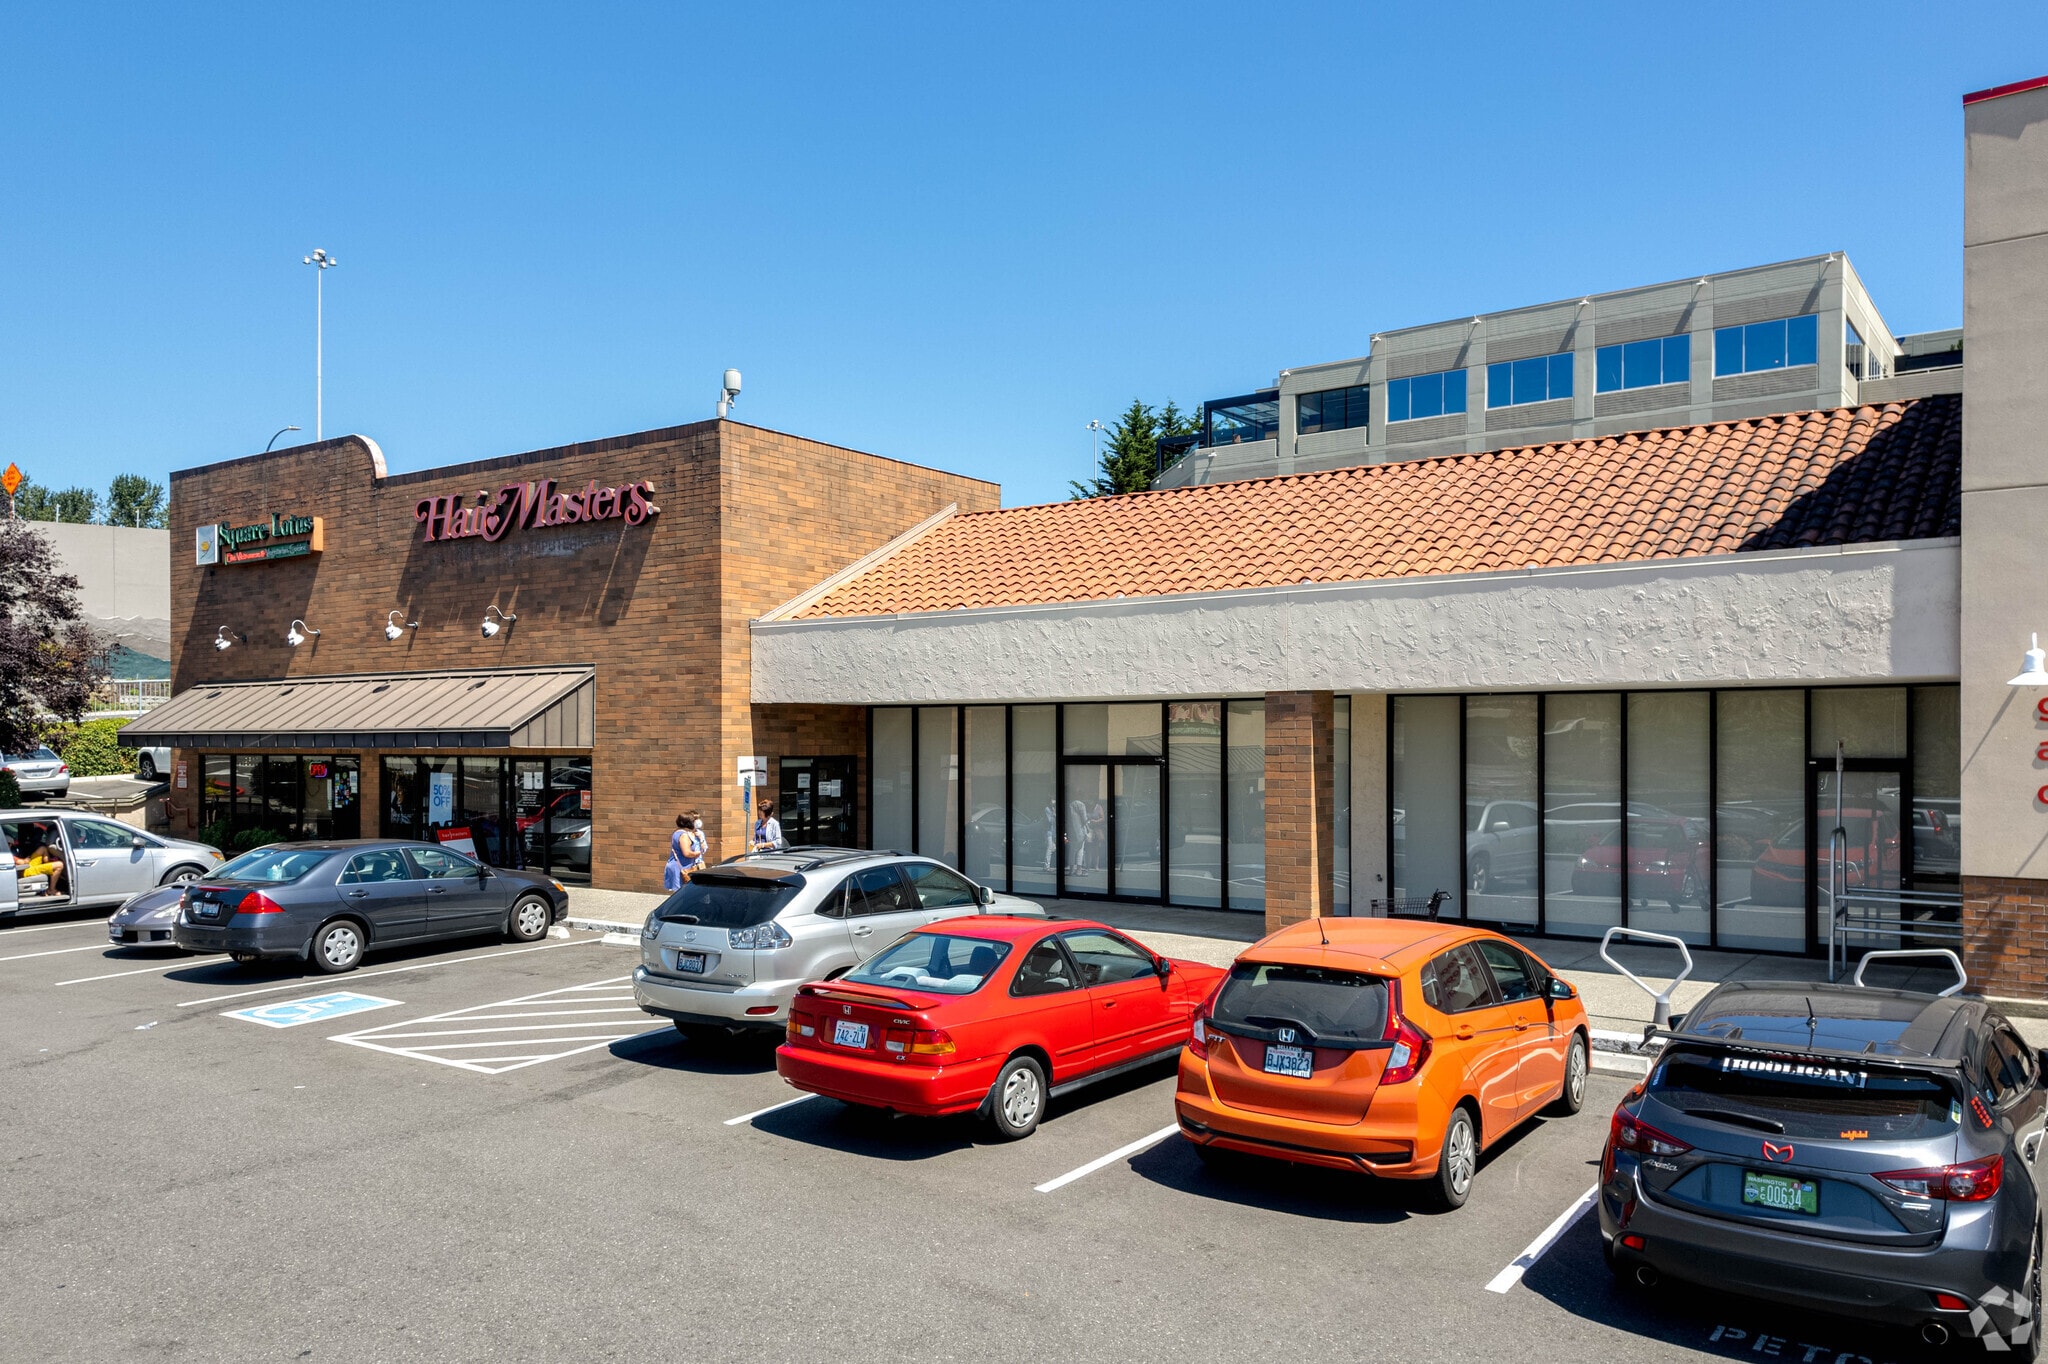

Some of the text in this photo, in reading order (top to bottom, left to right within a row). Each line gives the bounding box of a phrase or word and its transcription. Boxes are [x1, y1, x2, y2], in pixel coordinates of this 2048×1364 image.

[414, 478, 656, 543] Hair Masters
[219, 512, 313, 550] Square Lotus
[309, 763, 326, 776] OPEN
[433, 784, 451, 796] 50%
[433, 796, 451, 807] OFF
[1267, 1053, 1310, 1072] BJX3823
[1747, 1176, 1787, 1187] WASHINGTON
[1767, 1184, 1802, 1208] 00634
[1709, 1325, 1896, 1364] PETC
